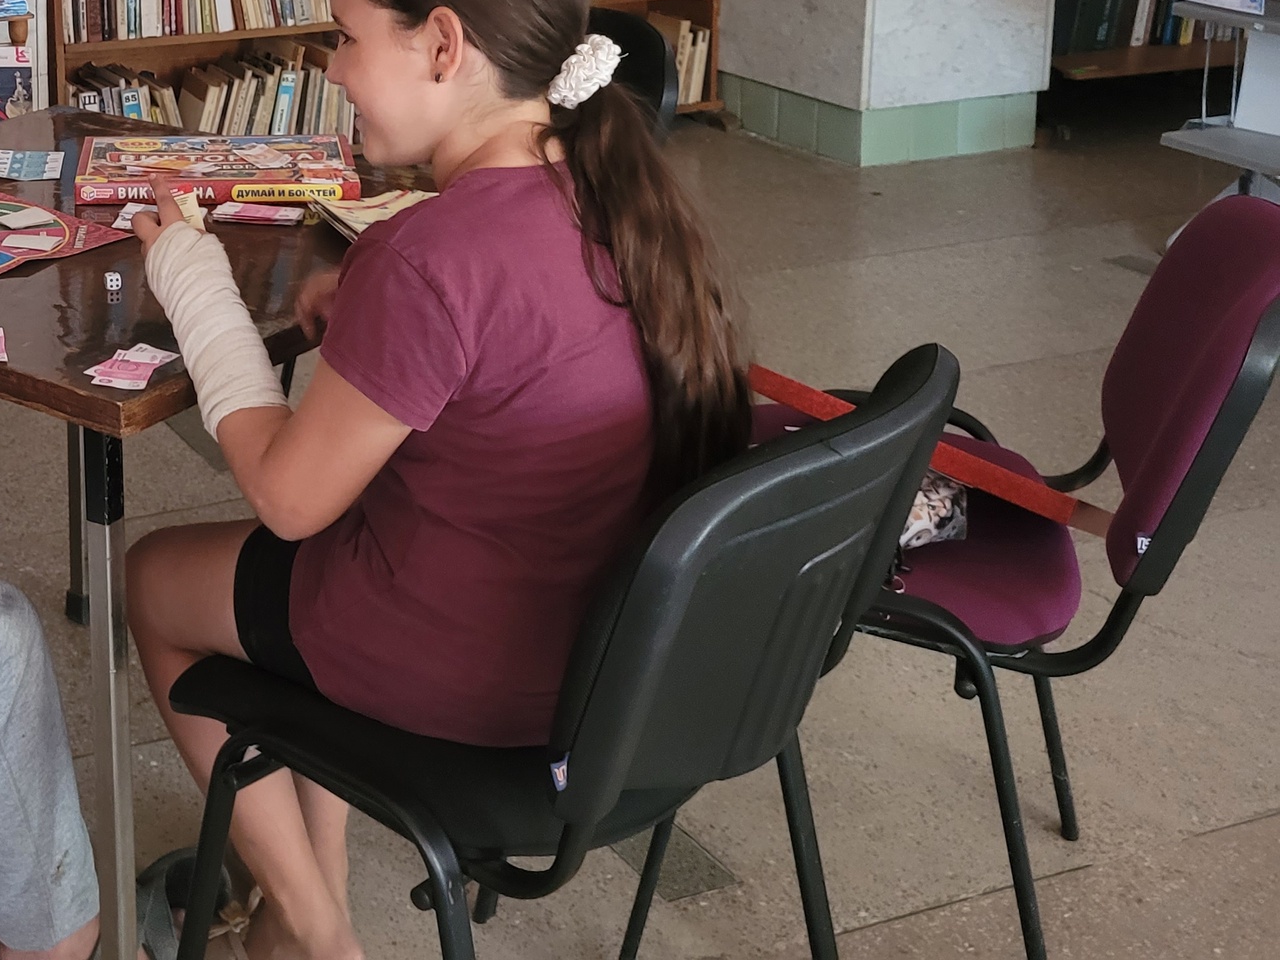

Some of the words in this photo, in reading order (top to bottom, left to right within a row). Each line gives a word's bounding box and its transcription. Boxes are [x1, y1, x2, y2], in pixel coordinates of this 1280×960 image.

[124, 93, 137, 104] 85
[118, 187, 215, 199] ВИКТНА
[237, 188, 275, 198] ДУМАЙ
[278, 189, 285, 197] И
